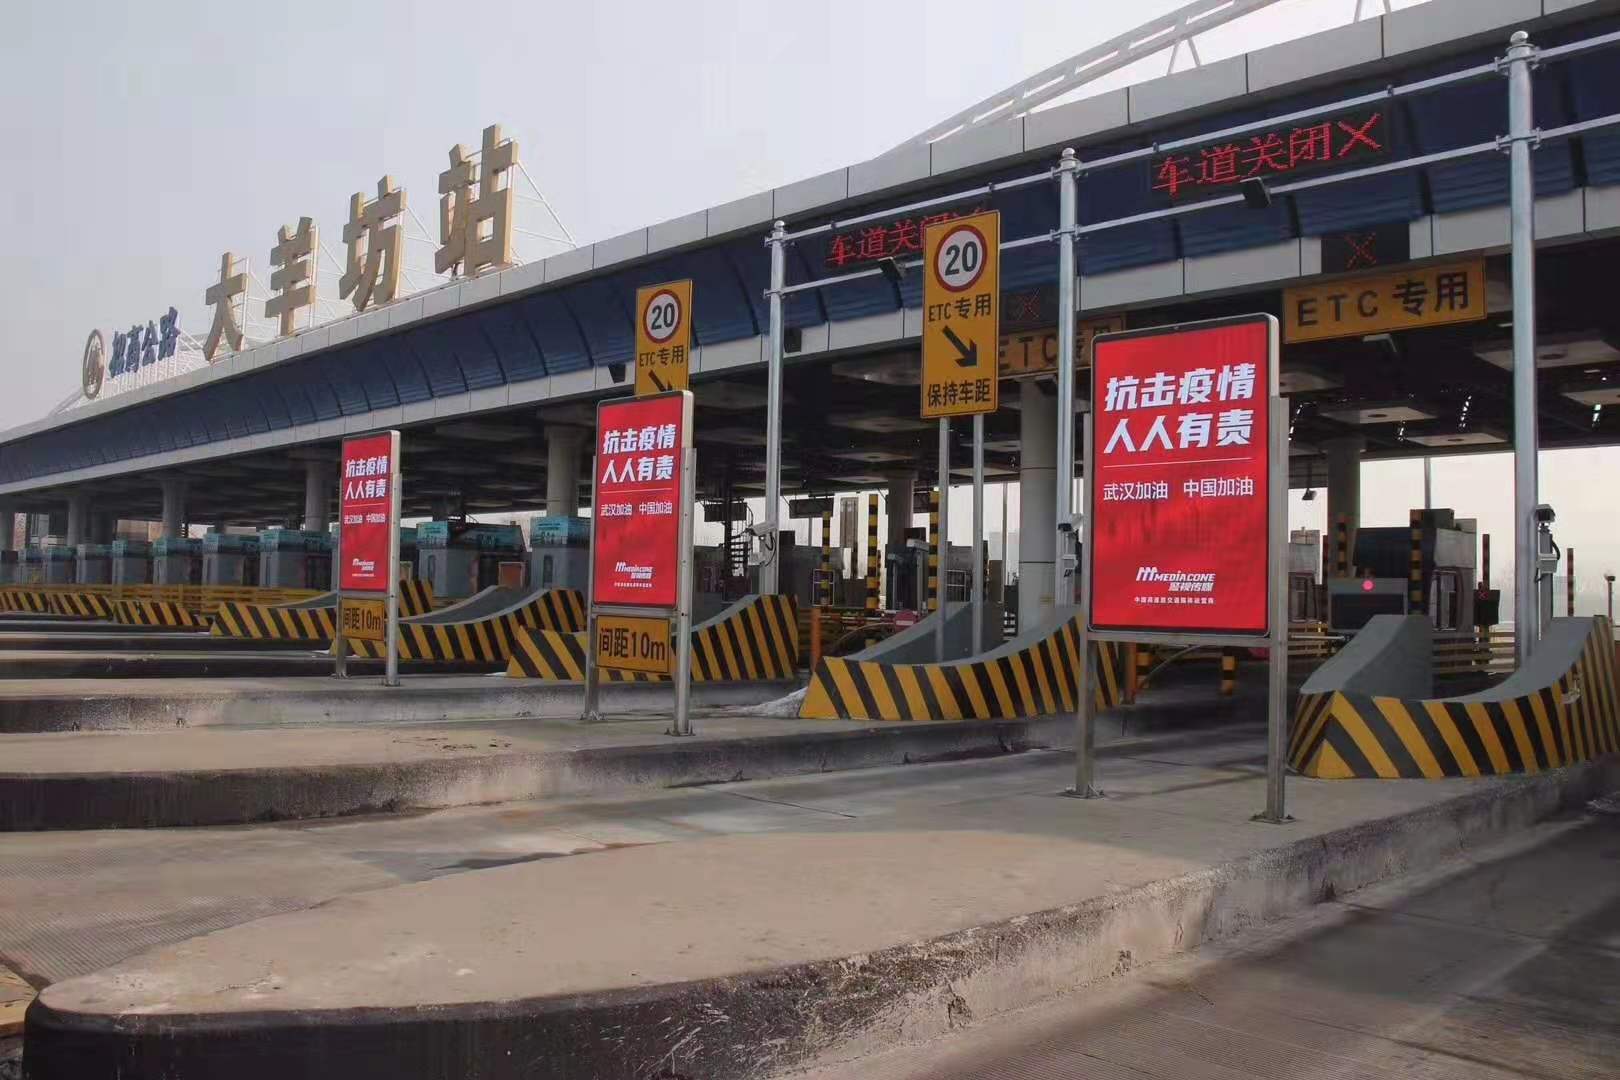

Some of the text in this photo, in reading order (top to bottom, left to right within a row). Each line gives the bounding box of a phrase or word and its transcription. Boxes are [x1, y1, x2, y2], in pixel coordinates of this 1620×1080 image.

[1153, 121, 1331, 198] 车道关闭
[203, 123, 519, 363] 大羊坊站
[944, 240, 978, 276] 20
[928, 293, 991, 322] ETC 专用
[1297, 271, 1468, 327] ETC 专用
[651, 302, 675, 330] 20
[640, 344, 684, 367] ETC 专用
[927, 378, 992, 407] 保持车距
[1103, 362, 1256, 412] 抗击疫情
[602, 423, 677, 455] 抗击疫情
[1103, 408, 1254, 454] 人人有责
[345, 455, 388, 478] 抗击疫情
[601, 455, 675, 484] 人人有责
[344, 479, 387, 501] 人人有责
[1103, 475, 1254, 501] 武汉加油 中国加油
[600, 501, 673, 517] 武汉加油 中国加油
[599, 627, 666, 661] 间距10m
